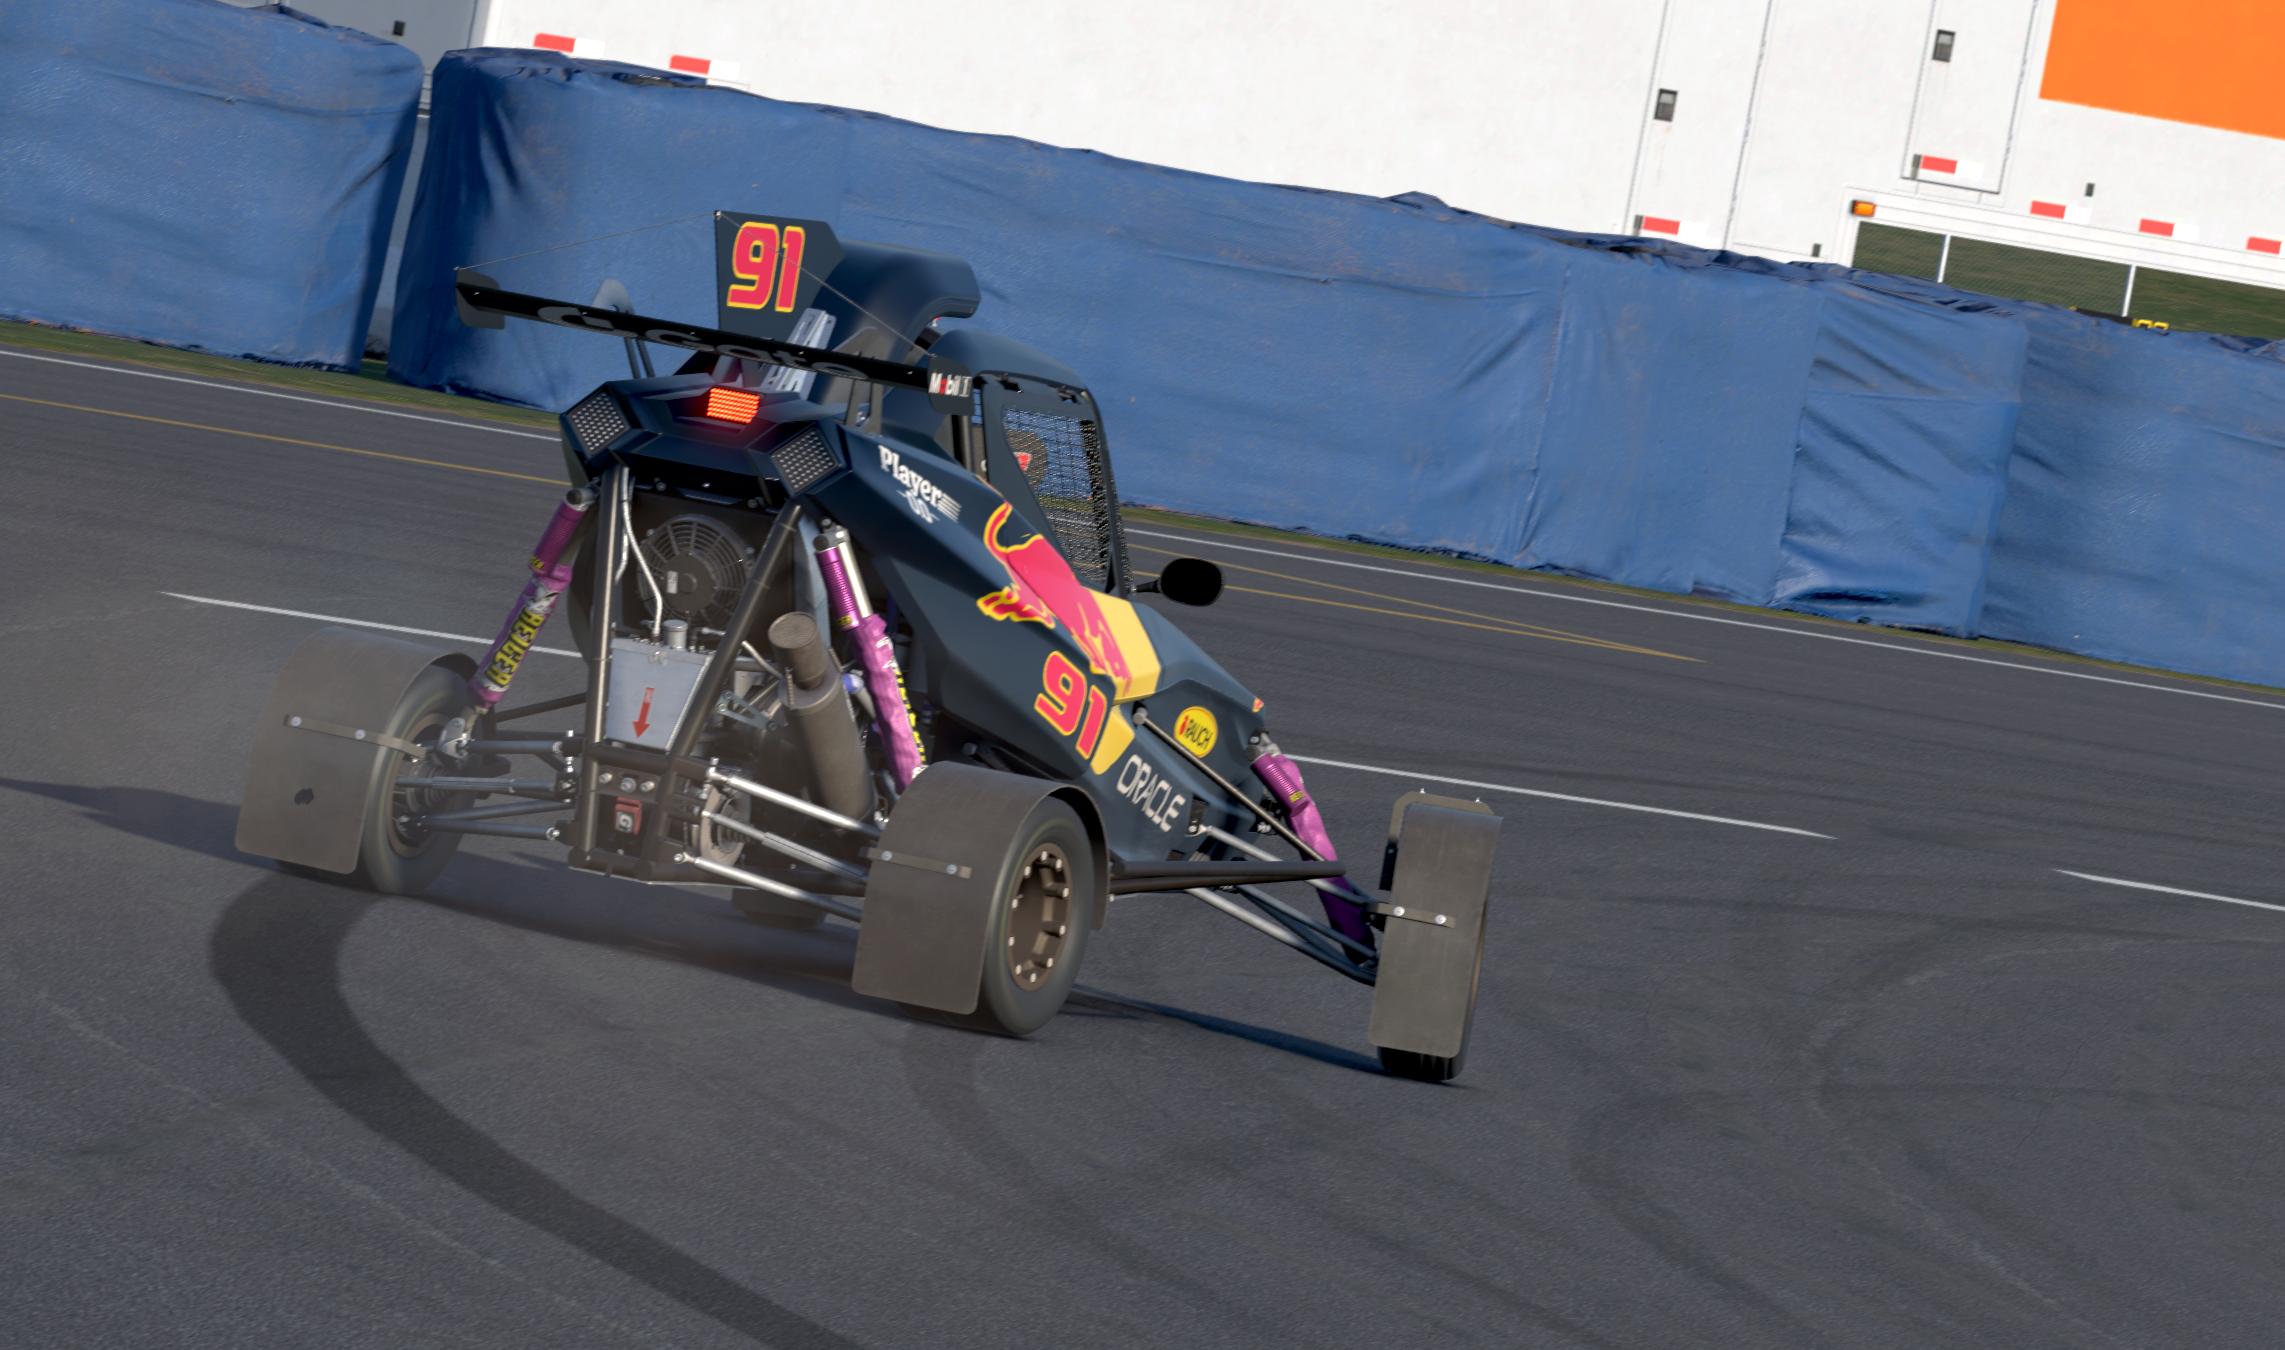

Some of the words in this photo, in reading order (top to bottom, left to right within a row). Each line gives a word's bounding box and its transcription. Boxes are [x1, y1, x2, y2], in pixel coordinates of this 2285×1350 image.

[727, 221, 805, 313] 91
[928, 372, 961, 396] Mobil
[878, 444, 943, 508] Player
[485, 607, 545, 686] REIGER
[1034, 650, 1107, 760] 91
[1184, 718, 1214, 751] RAUCH
[1116, 754, 1187, 833] ORACLE
